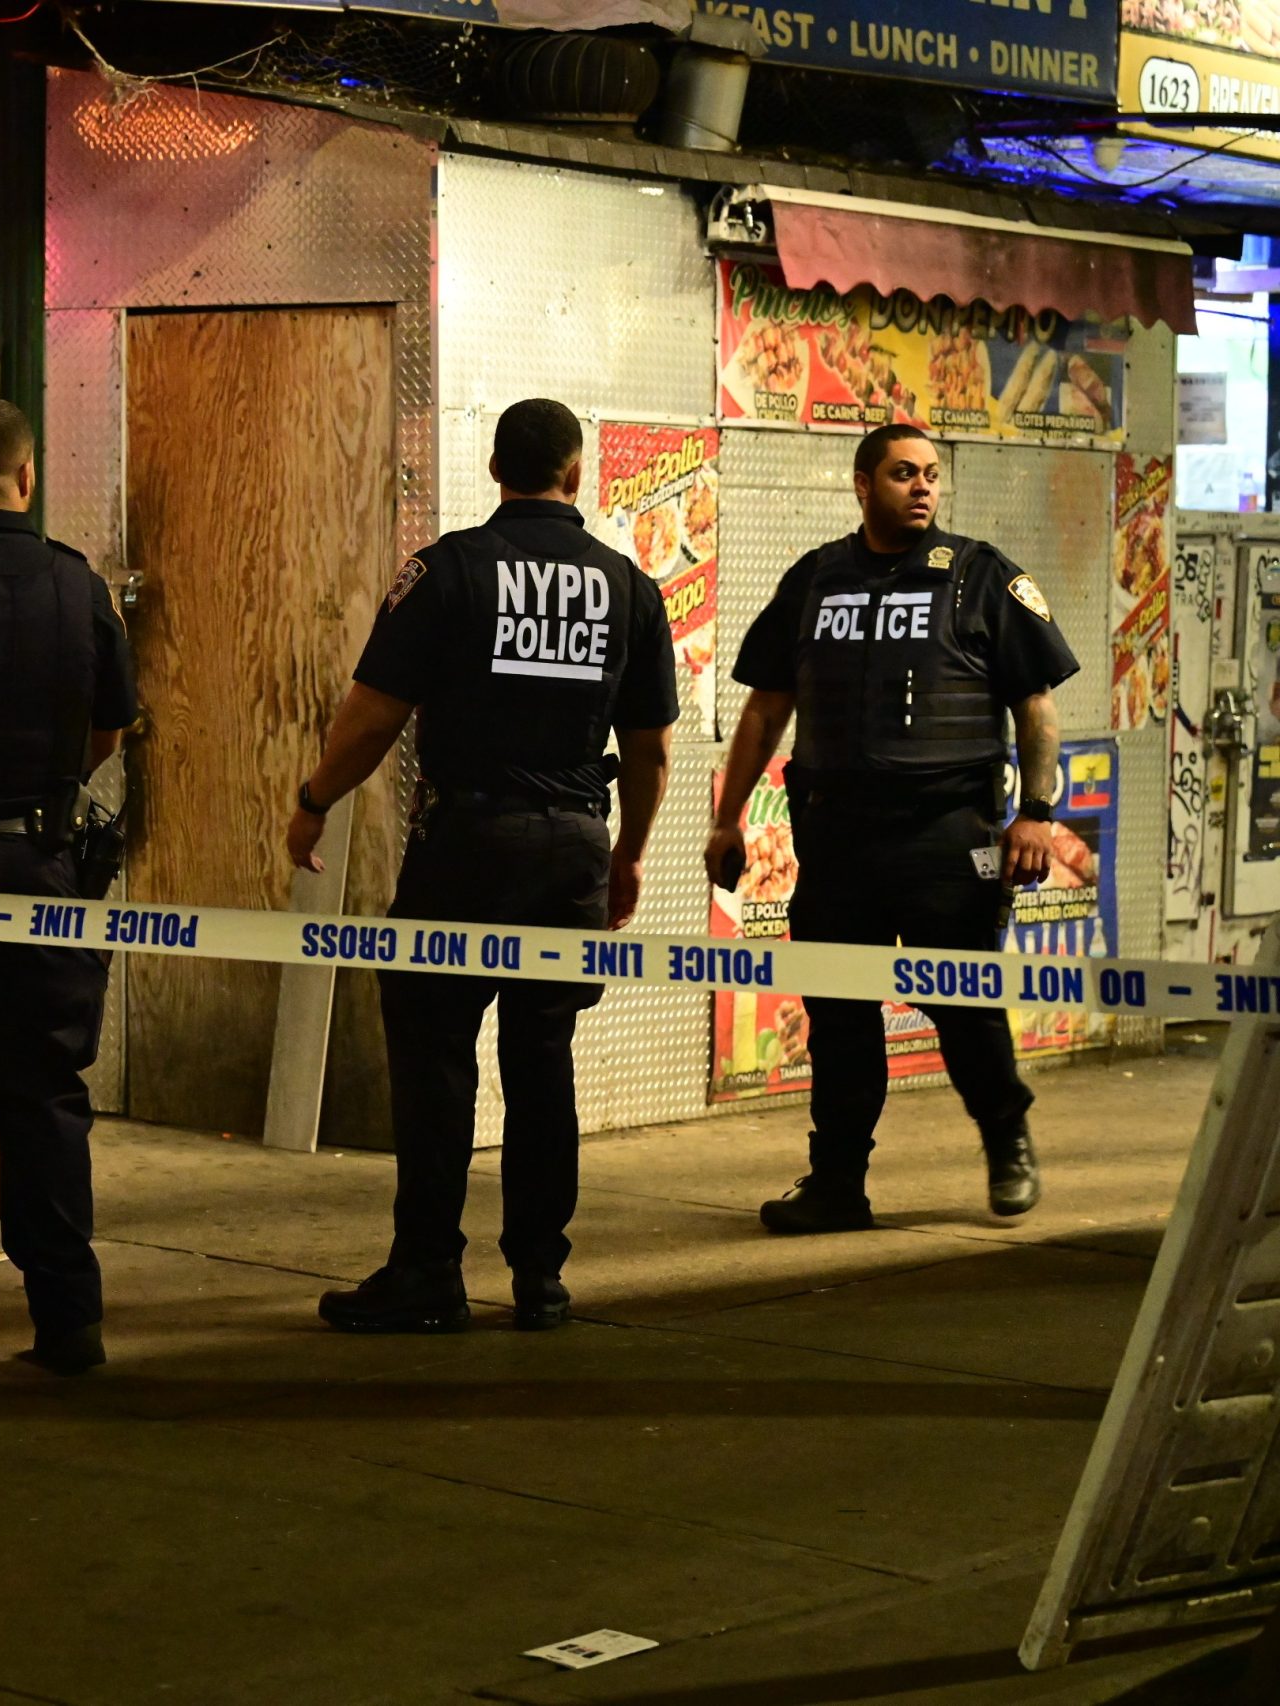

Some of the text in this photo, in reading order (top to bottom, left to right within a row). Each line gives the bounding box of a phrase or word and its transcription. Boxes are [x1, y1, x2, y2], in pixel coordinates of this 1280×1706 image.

[850, 20, 958, 69] LUNCH
[990, 39, 1099, 88] DINNER
[1149, 72, 1191, 112] 1623
[607, 436, 705, 517] Papi Pollo
[496, 560, 610, 620] NYPD
[493, 615, 610, 664] POLICE
[814, 606, 931, 640] POLICE
[30, 903, 86, 938] LINE
[105, 909, 199, 948] POLICE
[743, 903, 755, 920] DE
[302, 922, 773, 986] POLICE LINE DO NOT CROSS
[893, 958, 1002, 998] CROSS
[1019, 965, 1083, 1003] NOT
[1100, 968, 1145, 1007] DO
